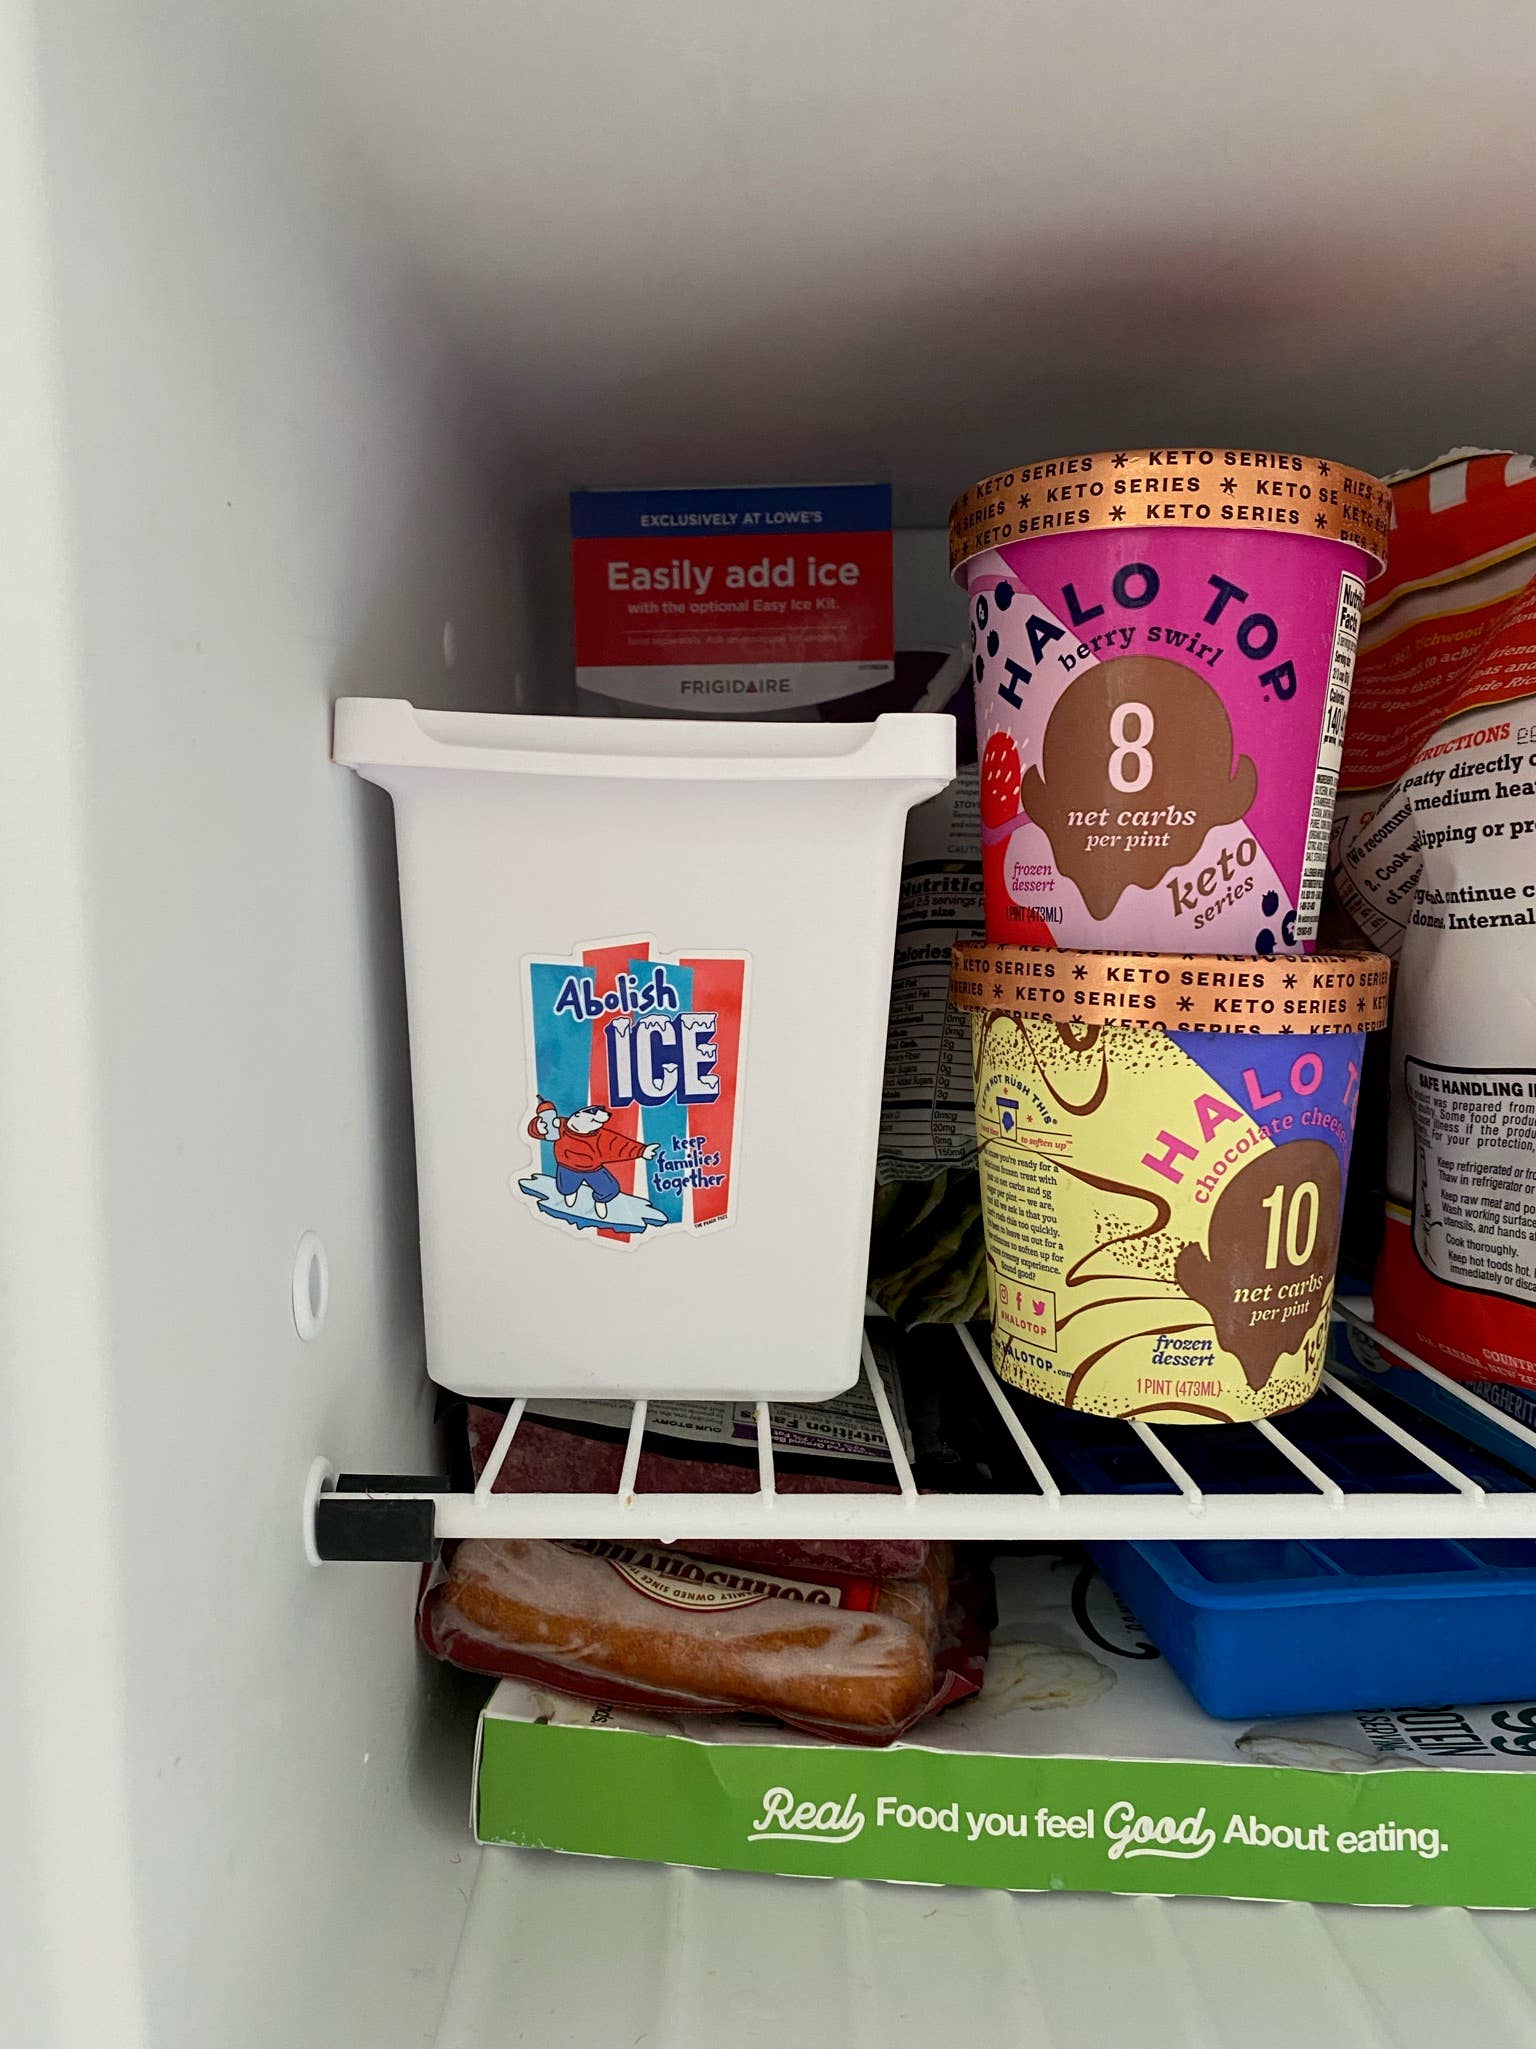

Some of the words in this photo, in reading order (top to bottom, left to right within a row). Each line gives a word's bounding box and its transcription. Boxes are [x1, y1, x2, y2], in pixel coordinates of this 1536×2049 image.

[976, 473, 1014, 499] KETO
[1021, 457, 1093, 483] SERIES
[1149, 450, 1214, 467] KETO
[1224, 450, 1303, 472] SERIES
[1047, 481, 1104, 503] KETO
[1113, 476, 1200, 495] SERIES
[1256, 479, 1311, 499] KETO
[640, 513, 737, 528] EXCLUSIVELY
[742, 512, 763, 525] AT
[765, 511, 823, 525] LOWE'S
[975, 523, 1012, 548] KETO
[1018, 508, 1090, 534] SERIES
[1146, 503, 1211, 520] KETO
[1221, 504, 1300, 525] SERIES
[607, 559, 714, 596] Easily
[725, 557, 795, 589] add
[807, 556, 861, 587] ice
[628, 601, 659, 614] with
[662, 600, 686, 613] the
[690, 599, 749, 615] optional
[753, 598, 786, 613] Easy
[791, 598, 812, 611] Ice
[998, 562, 1161, 710] HALO
[1058, 625, 1137, 672] berry
[1147, 625, 1226, 669] swirl
[681, 679, 791, 695] FRIGIDAIRE
[1107, 701, 1155, 794] 8
[1403, 770, 1446, 792] patty
[1449, 753, 1524, 774] directly
[1414, 787, 1491, 811] medium
[1066, 808, 1113, 828] net
[1117, 805, 1197, 827] carbs
[1085, 834, 1122, 852] per
[1124, 830, 1170, 852] pint
[1482, 823, 1505, 837] or
[1011, 861, 1053, 880] frozen
[1166, 836, 1257, 919] keto
[1364, 879, 1381, 892] 2.
[1375, 850, 1412, 881] Cook
[1012, 878, 1055, 892] dessert
[931, 896, 976, 908] servings
[1193, 873, 1255, 930] series
[963, 957, 990, 974] KETO
[995, 960, 1056, 978] SERIES
[1107, 967, 1171, 984] KETO
[1180, 971, 1265, 988] SERIES
[1313, 973, 1355, 989] KETO
[555, 967, 677, 1020] Abolish
[1016, 986, 1066, 1004] KETO
[1074, 990, 1157, 1010] SERIES
[1214, 998, 1275, 1014] KETO
[1283, 999, 1347, 1014] SERIES
[605, 1012, 720, 1108] ICE
[989, 1073, 1003, 1089] NOT
[1004, 1074, 1031, 1096] RUSH
[1419, 1073, 1440, 1092] SAFE
[1442, 1079, 1524, 1098] HANDLING
[1140, 1051, 1324, 1185] HALO
[1440, 1109, 1466, 1123] Some
[1470, 1112, 1497, 1124] food
[1452, 1100, 1503, 1114] prepared
[1510, 1101, 1535, 1114] from
[1465, 1123, 1474, 1135] if
[1481, 1124, 1500, 1136] the
[672, 1135, 707, 1153] keep
[1020, 1136, 1029, 1144] to
[1029, 1136, 1053, 1148] soften
[1447, 1134, 1470, 1146] your
[1476, 1136, 1535, 1153] protection,
[656, 1151, 721, 1173] families
[1018, 1159, 1038, 1171] ready
[1039, 1161, 1051, 1171] for
[1194, 1113, 1294, 1204] chocolate
[1437, 1157, 1455, 1170] Keep
[1456, 1161, 1512, 1177] refrigerated
[1513, 1167, 1524, 1178] or
[653, 1170, 725, 1196] together
[1020, 1171, 1037, 1182] treat
[1038, 1175, 1057, 1185] with
[1438, 1169, 1459, 1184] Thaw
[1460, 1173, 1469, 1185] in
[1471, 1175, 1523, 1193] refrigerator
[1524, 1184, 1535, 1195] or
[1027, 1186, 1041, 1195] and
[1042, 1189, 1052, 1200] 5g
[1440, 1188, 1458, 1203] Keep
[1460, 1195, 1479, 1206] raw
[1480, 1197, 1503, 1210] meat
[1503, 1200, 1521, 1213] and
[1026, 1198, 1038, 1207] we
[1039, 1201, 1055, 1212] are,
[1026, 1209, 1041, 1221] that
[1041, 1214, 1057, 1224] you
[1442, 1201, 1462, 1217] Wash
[1464, 1207, 1500, 1224] working
[1018, 1221, 1030, 1230] too
[1030, 1224, 1061, 1239] quickly.
[1261, 1180, 1320, 1270] 10
[1478, 1223, 1495, 1235] and
[1497, 1225, 1527, 1240] hands
[1021, 1233, 1030, 1242] us
[1030, 1236, 1043, 1246] out
[1044, 1238, 1057, 1249] for
[1445, 1232, 1465, 1248] Cook
[1466, 1239, 1519, 1259] thoroughly.
[1018, 1245, 1039, 1257] soften
[1039, 1252, 1050, 1262] up
[1051, 1252, 1064, 1263] for
[1448, 1249, 1467, 1265] Keep
[1469, 1255, 1484, 1267] hot
[1486, 1258, 1513, 1273] foods
[1515, 1263, 1531, 1277] hot.
[1021, 1258, 1061, 1275] experience.
[1450, 1262, 1502, 1285] immediately
[1504, 1274, 1514, 1285] or
[1233, 1287, 1272, 1303] net
[1277, 1274, 1324, 1300] carbs
[1249, 1308, 1280, 1327] per
[1280, 1299, 1310, 1323] pint
[1152, 1334, 1213, 1353] frozen
[1152, 1351, 1216, 1367] dessert
[1137, 1378, 1142, 1394] 1
[1144, 1380, 1172, 1396] PINT
[1175, 1380, 1222, 1398] (473ML)
[643, 1576, 670, 1594] SINCE
[672, 1590, 715, 1601] OWNED
[748, 1786, 866, 1844] Real
[876, 1796, 960, 1833] Food
[966, 1810, 1028, 1841] you
[1034, 1807, 1095, 1839] feel
[1103, 1800, 1217, 1861] Good
[1222, 1813, 1330, 1853] About
[1336, 1820, 1449, 1860] eating.
